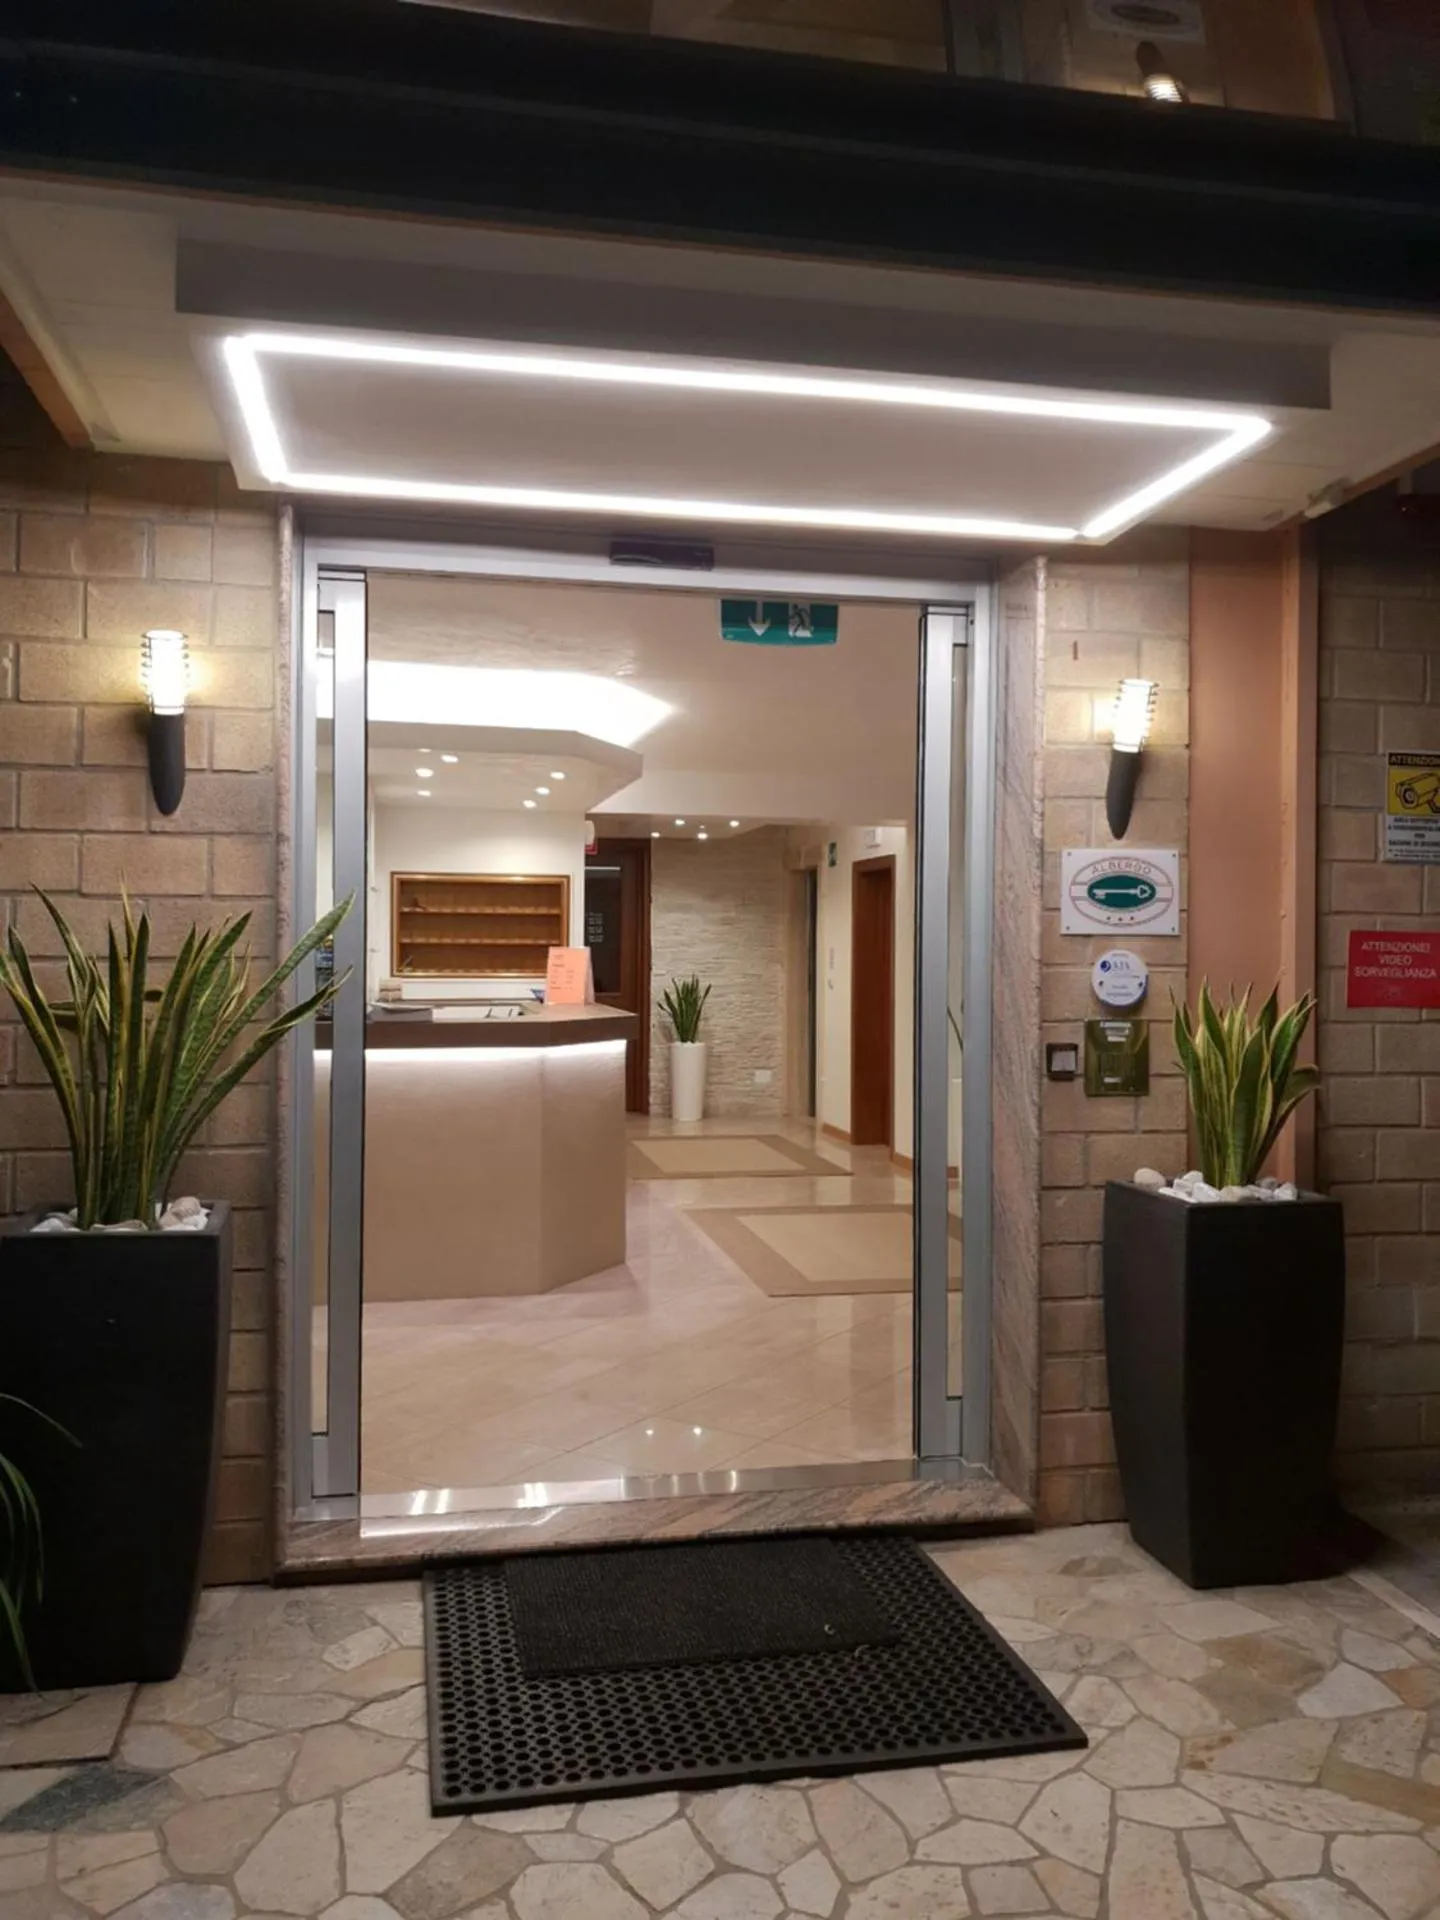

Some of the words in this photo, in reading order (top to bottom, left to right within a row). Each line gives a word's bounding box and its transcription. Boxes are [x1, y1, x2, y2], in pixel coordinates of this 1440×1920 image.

[1091, 860, 1152, 875] ALBERGO
[1378, 954, 1413, 966] VIDEO
[1354, 966, 1437, 979] SORVEGLIANZA
